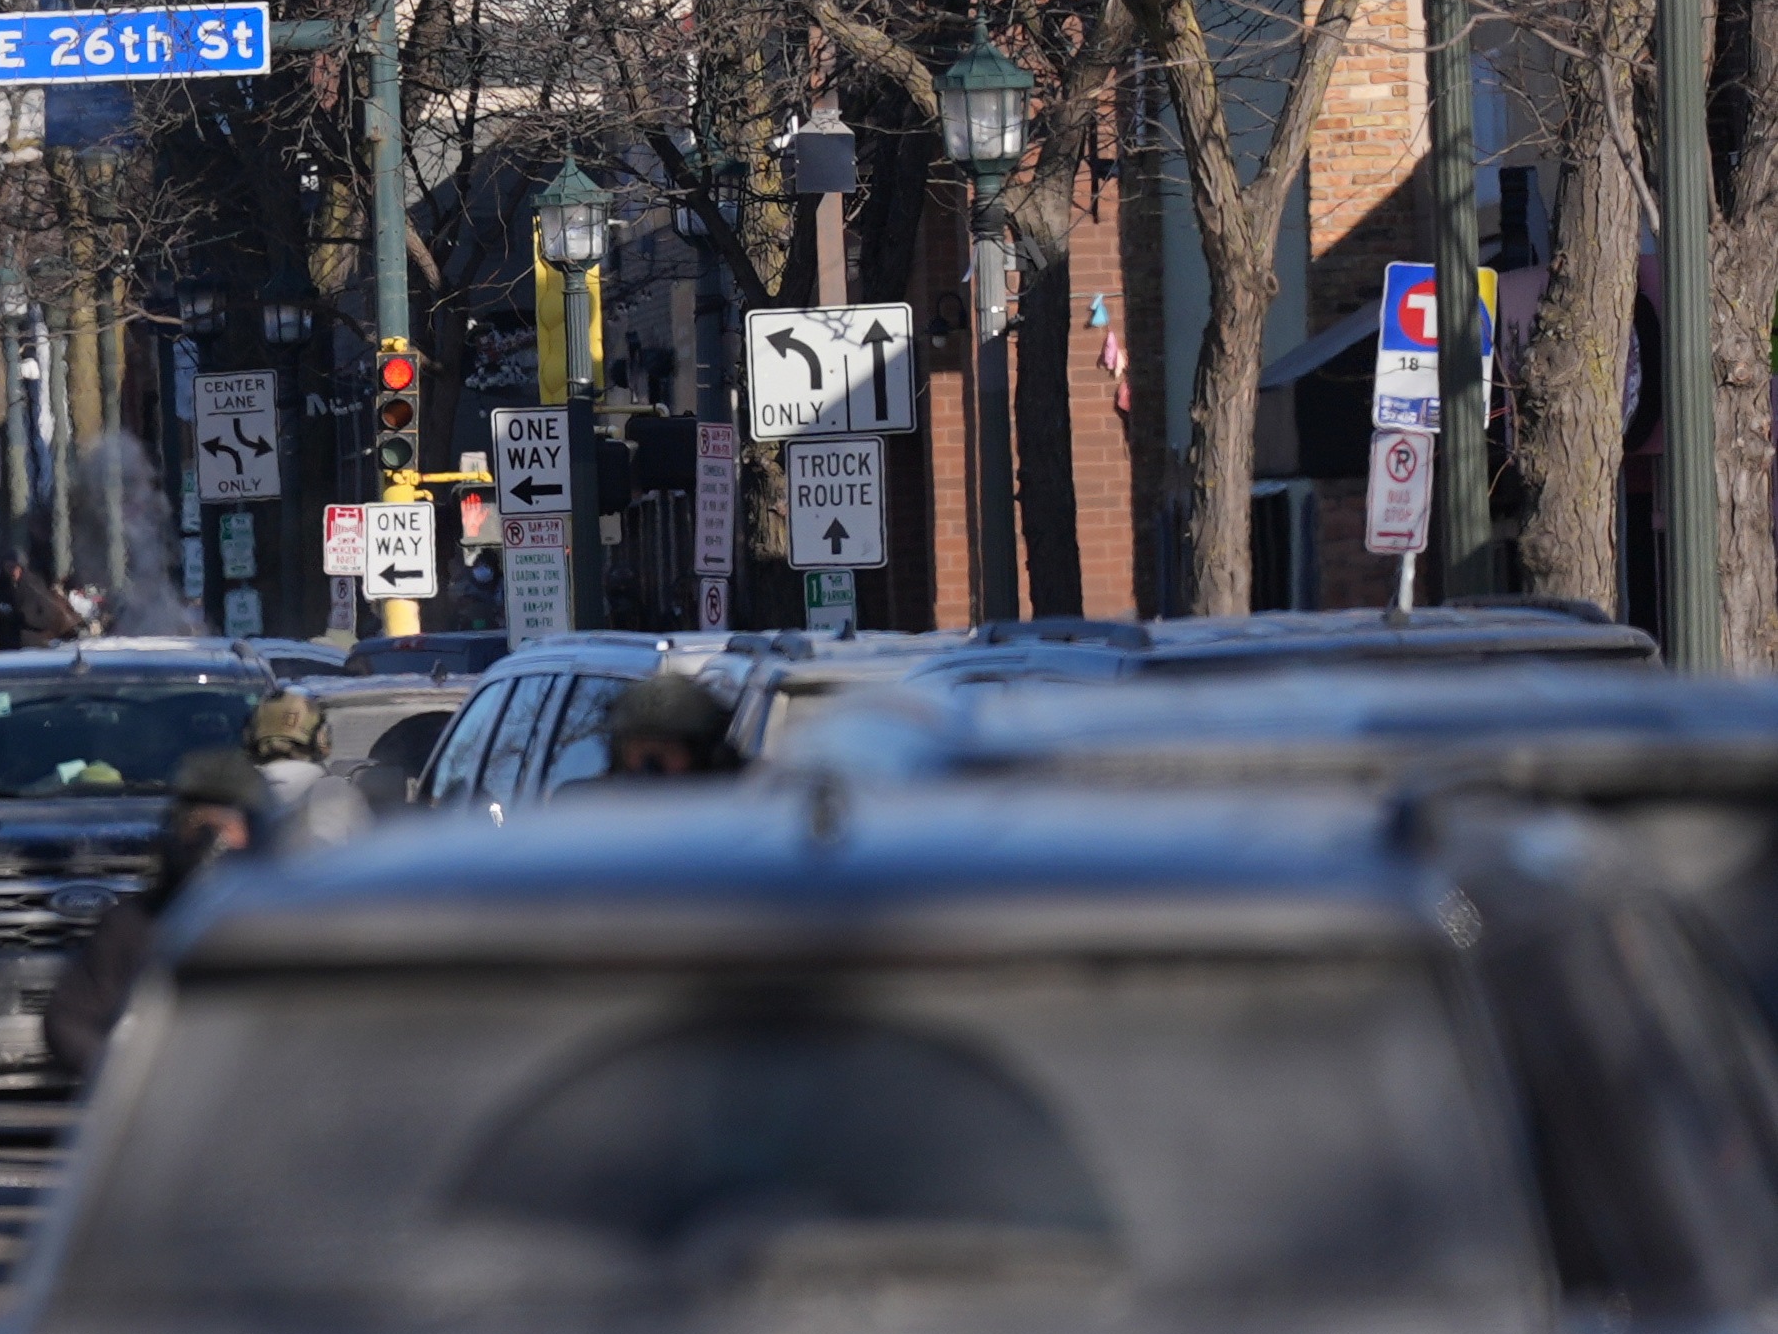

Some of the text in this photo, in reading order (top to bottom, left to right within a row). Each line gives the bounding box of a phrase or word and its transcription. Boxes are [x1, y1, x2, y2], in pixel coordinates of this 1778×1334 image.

[47, 23, 175, 68] 26th
[197, 19, 254, 62] St
[1398, 356, 1420, 372] 18
[203, 378, 266, 394] CENTER
[213, 394, 257, 411] LANE
[761, 400, 824, 427] ONLY
[507, 417, 560, 442] ONE
[506, 444, 561, 471] WAY
[797, 451, 872, 479] TRUCK
[217, 477, 263, 494] ONLY
[798, 482, 874, 509] ROUTE
[377, 511, 421, 532] ONE
[375, 536, 423, 557] WAY
